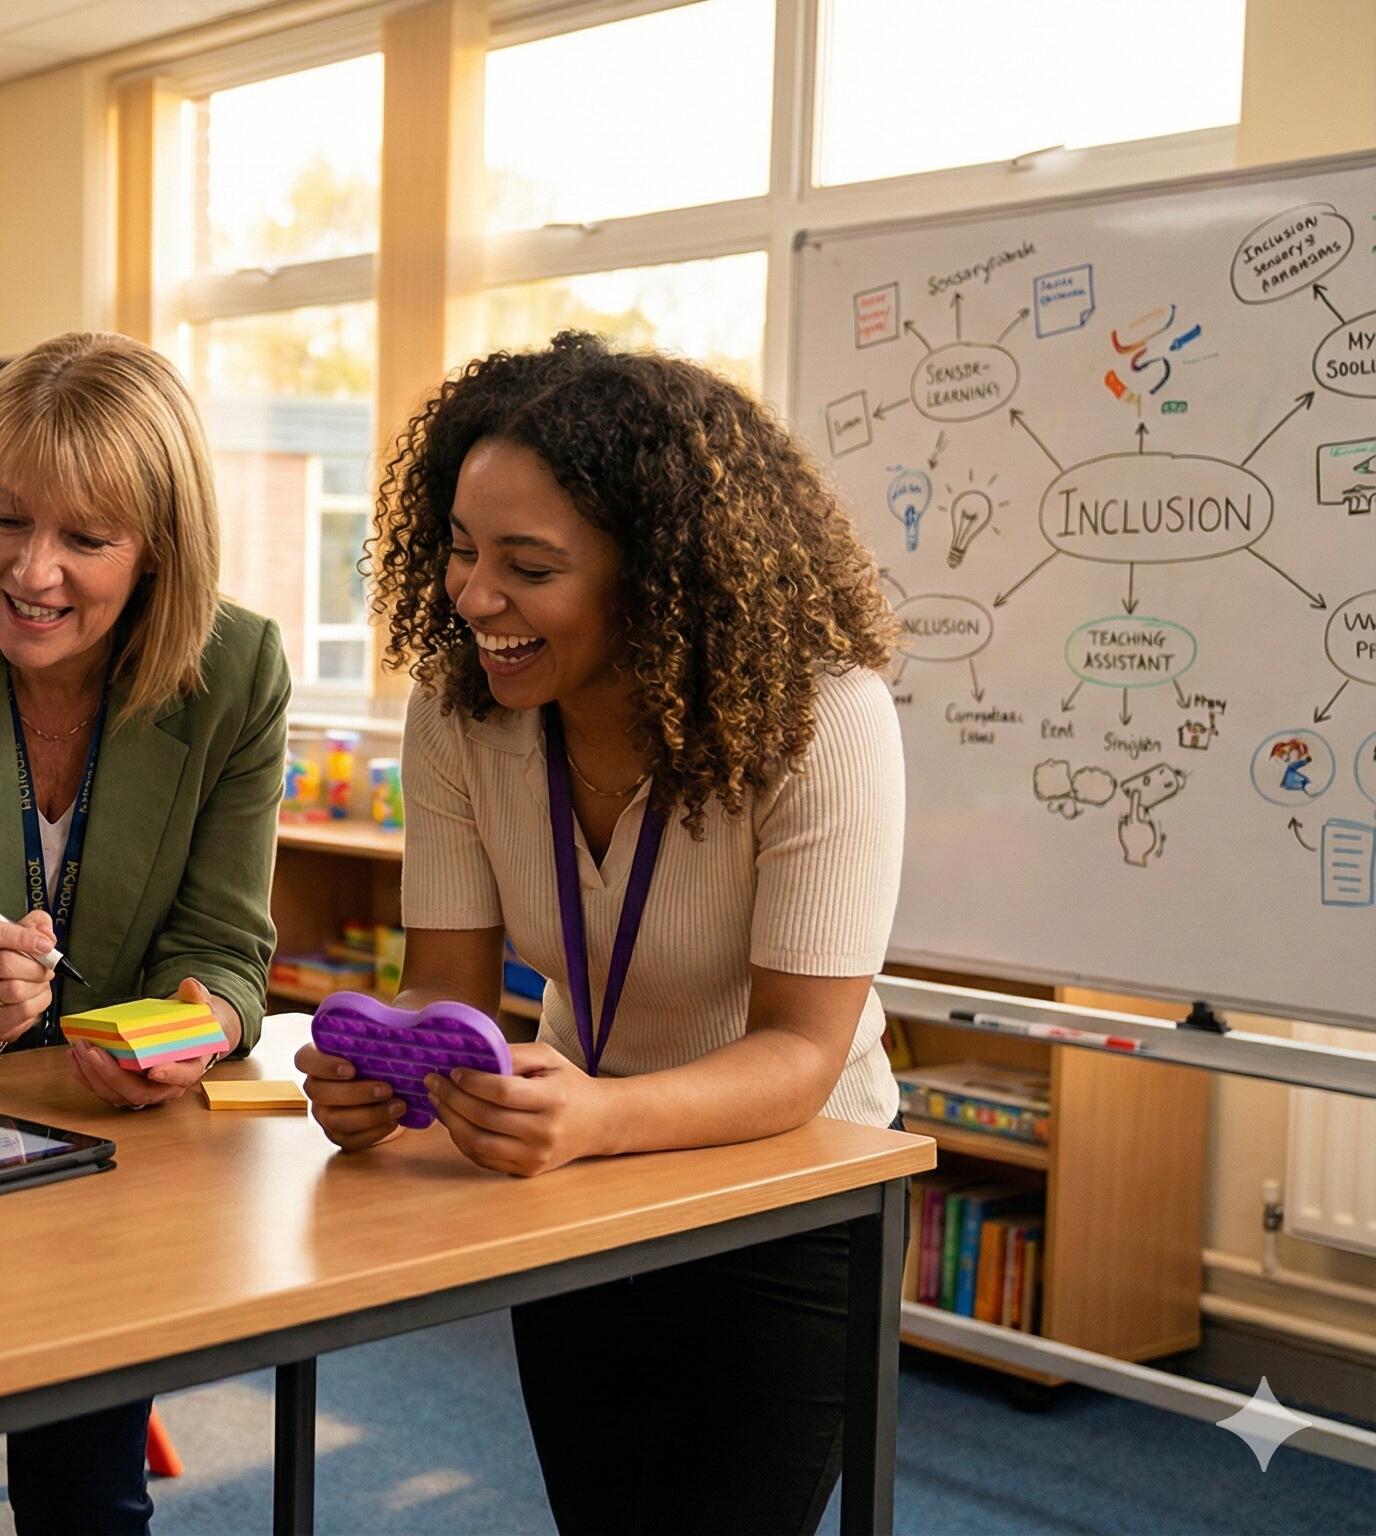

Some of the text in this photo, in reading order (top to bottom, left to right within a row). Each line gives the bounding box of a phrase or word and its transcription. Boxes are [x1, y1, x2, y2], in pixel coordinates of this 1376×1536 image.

[1348, 330, 1376, 351] MY
[1057, 487, 1252, 538] INCLUSION
[902, 617, 981, 637] NCLUSION
[1087, 629, 1167, 649] TEACHING
[1083, 651, 1175, 673] ASSISTANT
